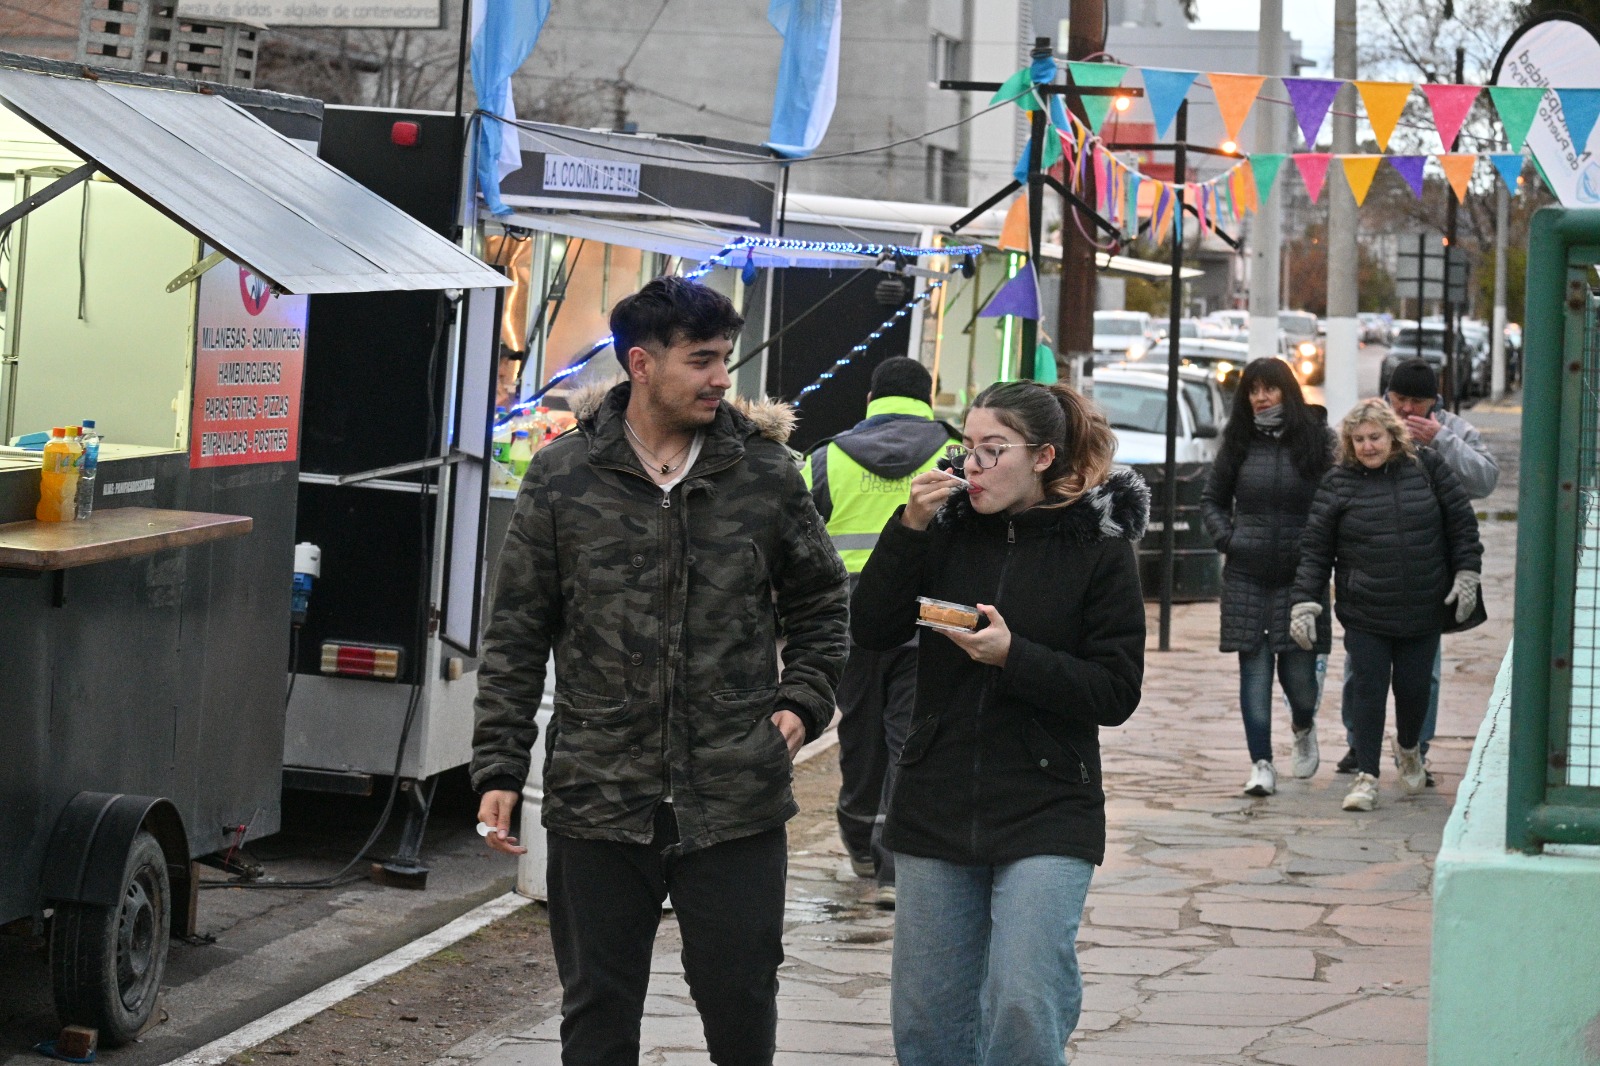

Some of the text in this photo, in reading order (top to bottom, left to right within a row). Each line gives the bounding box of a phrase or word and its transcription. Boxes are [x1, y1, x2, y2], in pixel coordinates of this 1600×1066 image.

[545, 160, 557, 186] LA
[602, 165, 615, 190] DE
[617, 167, 638, 193] ELBA
[202, 327, 246, 350] MILANESAS
[252, 327, 301, 350] SANDWICHES
[217, 362, 281, 385] HAMBURGUESAS
[204, 396, 230, 421] PAPAS
[230, 395, 258, 420] FRITAS
[262, 394, 289, 418] PIZZAS
[201, 430, 248, 457] EMPANADAS
[253, 428, 288, 453] POSTRES
[860, 481, 911, 493] URBA
